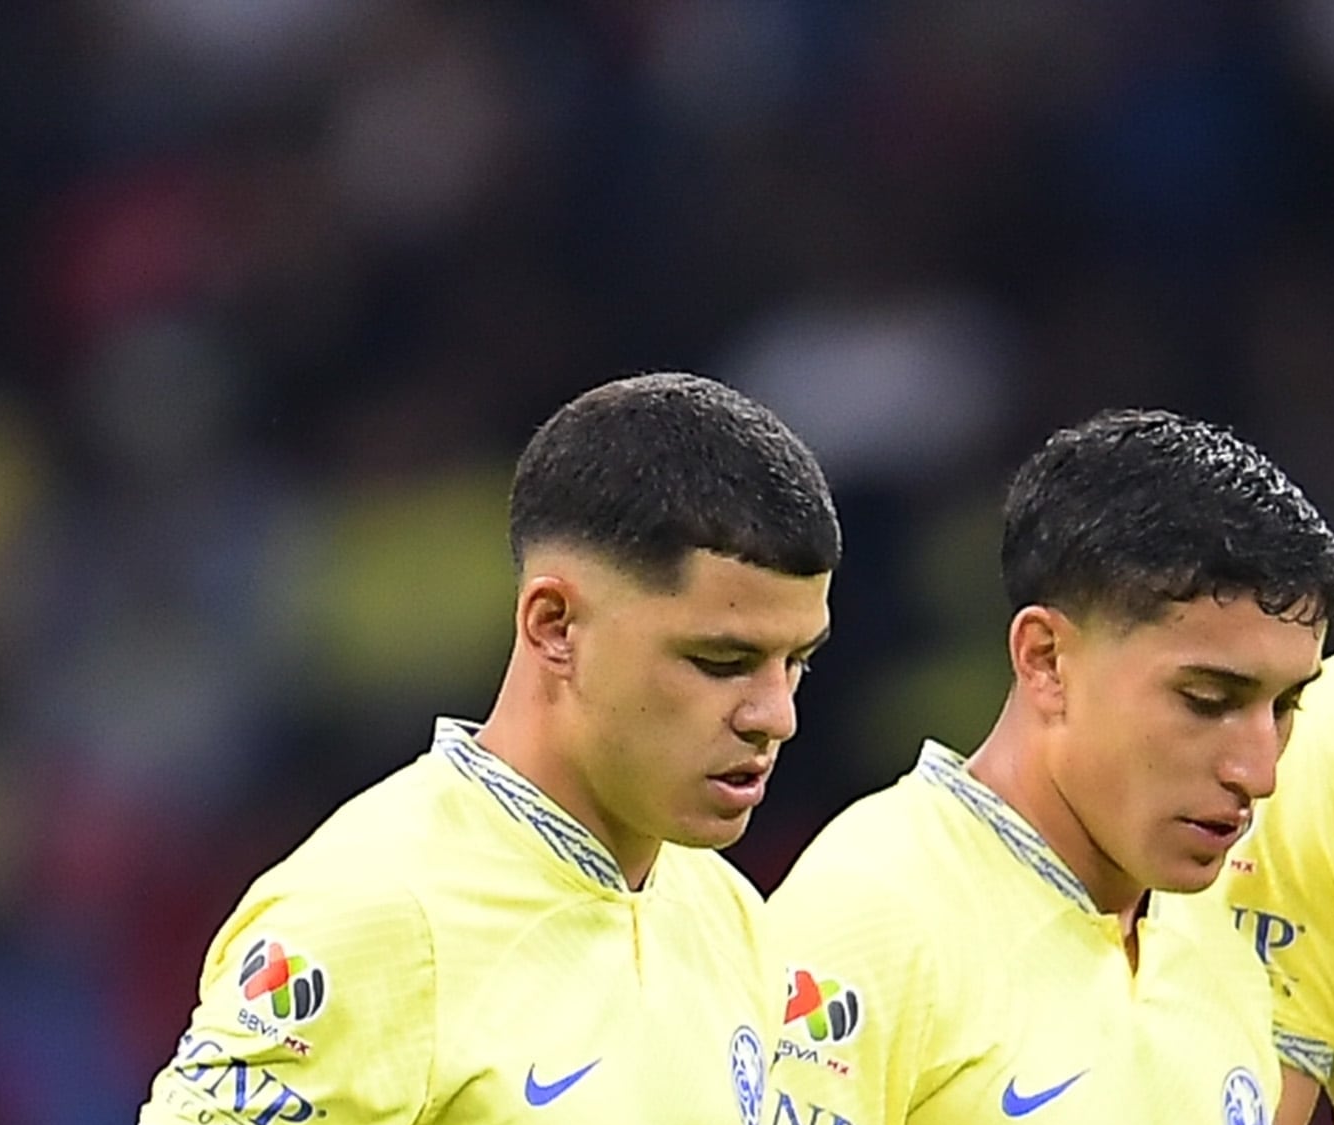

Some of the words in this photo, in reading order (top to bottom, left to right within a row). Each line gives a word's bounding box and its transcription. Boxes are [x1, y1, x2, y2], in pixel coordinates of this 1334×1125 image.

[237, 1008, 279, 1041] BBVA
[283, 1036, 310, 1056] MX
[777, 1038, 819, 1064] BVA
